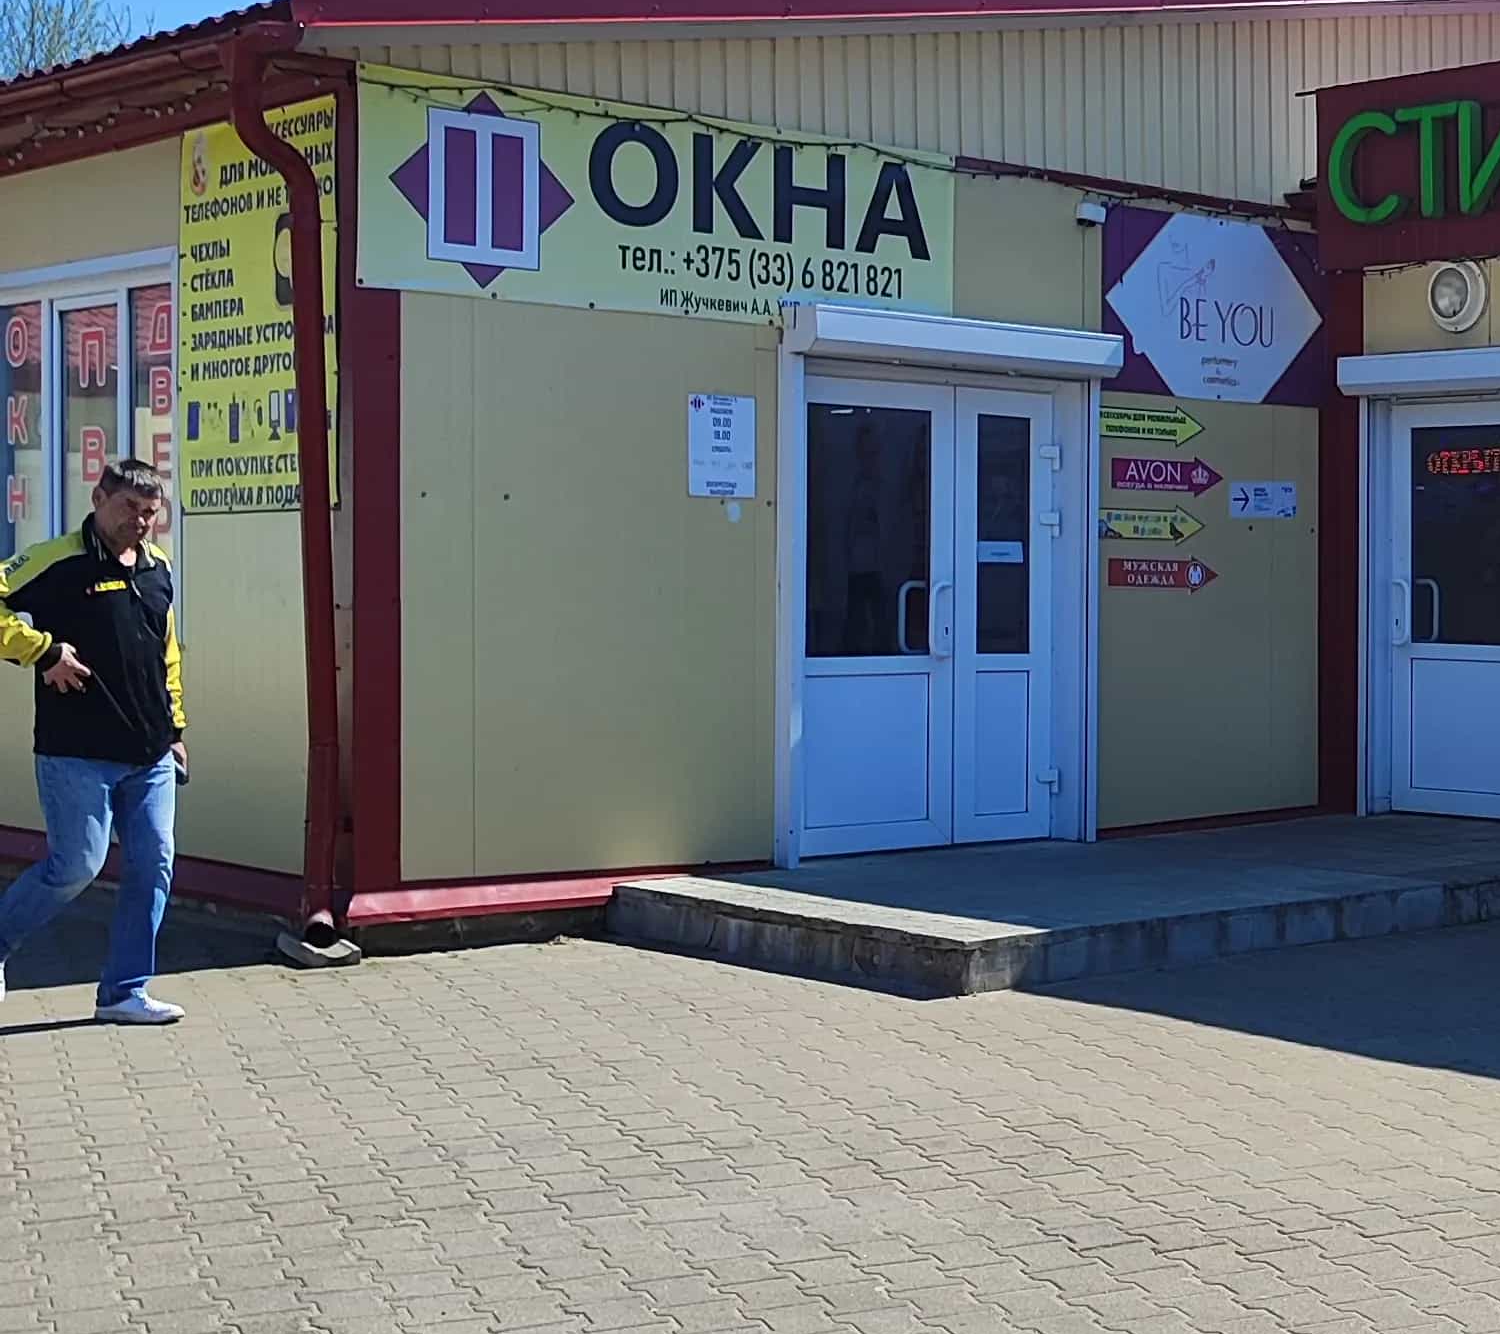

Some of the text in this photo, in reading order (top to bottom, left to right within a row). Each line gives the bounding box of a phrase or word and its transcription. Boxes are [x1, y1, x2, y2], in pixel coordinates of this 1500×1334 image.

[270, 107, 334, 141] СЕССУАРЫ
[220, 160, 244, 189] ДЛЯ
[589, 121, 931, 261] ОКНА
[184, 193, 252, 224] ТЕЛЕФОНОВ
[256, 190, 265, 209] И
[268, 186, 282, 208] НЕ
[191, 238, 230, 264] ЧЕХЛЫ
[191, 268, 234, 293] СТЁКЛА
[618, 244, 676, 276] тел.:
[683, 244, 741, 281] +375
[750, 247, 794, 293] (33)
[801, 256, 815, 290] 6
[191, 297, 244, 323] БАМПЕРА
[660, 287, 677, 308] ИП
[680, 289, 748, 317] Жучкевич
[1180, 297, 1274, 348] BE YOU
[191, 326, 253, 353] ЗАРЯДНЫЕ
[191, 351, 297, 382] И МНОГОЕ ДРУГО
[191, 458, 213, 478] ПРИ
[216, 454, 273, 478] ПОКУПКЕ
[1125, 460, 1181, 482] AVON
[191, 483, 300, 508] ПОКЛЕЙКА В ПОДА
[1122, 559, 1179, 572] МУЖСКАЯ
[1127, 573, 1176, 586] ОДЕЖДА
